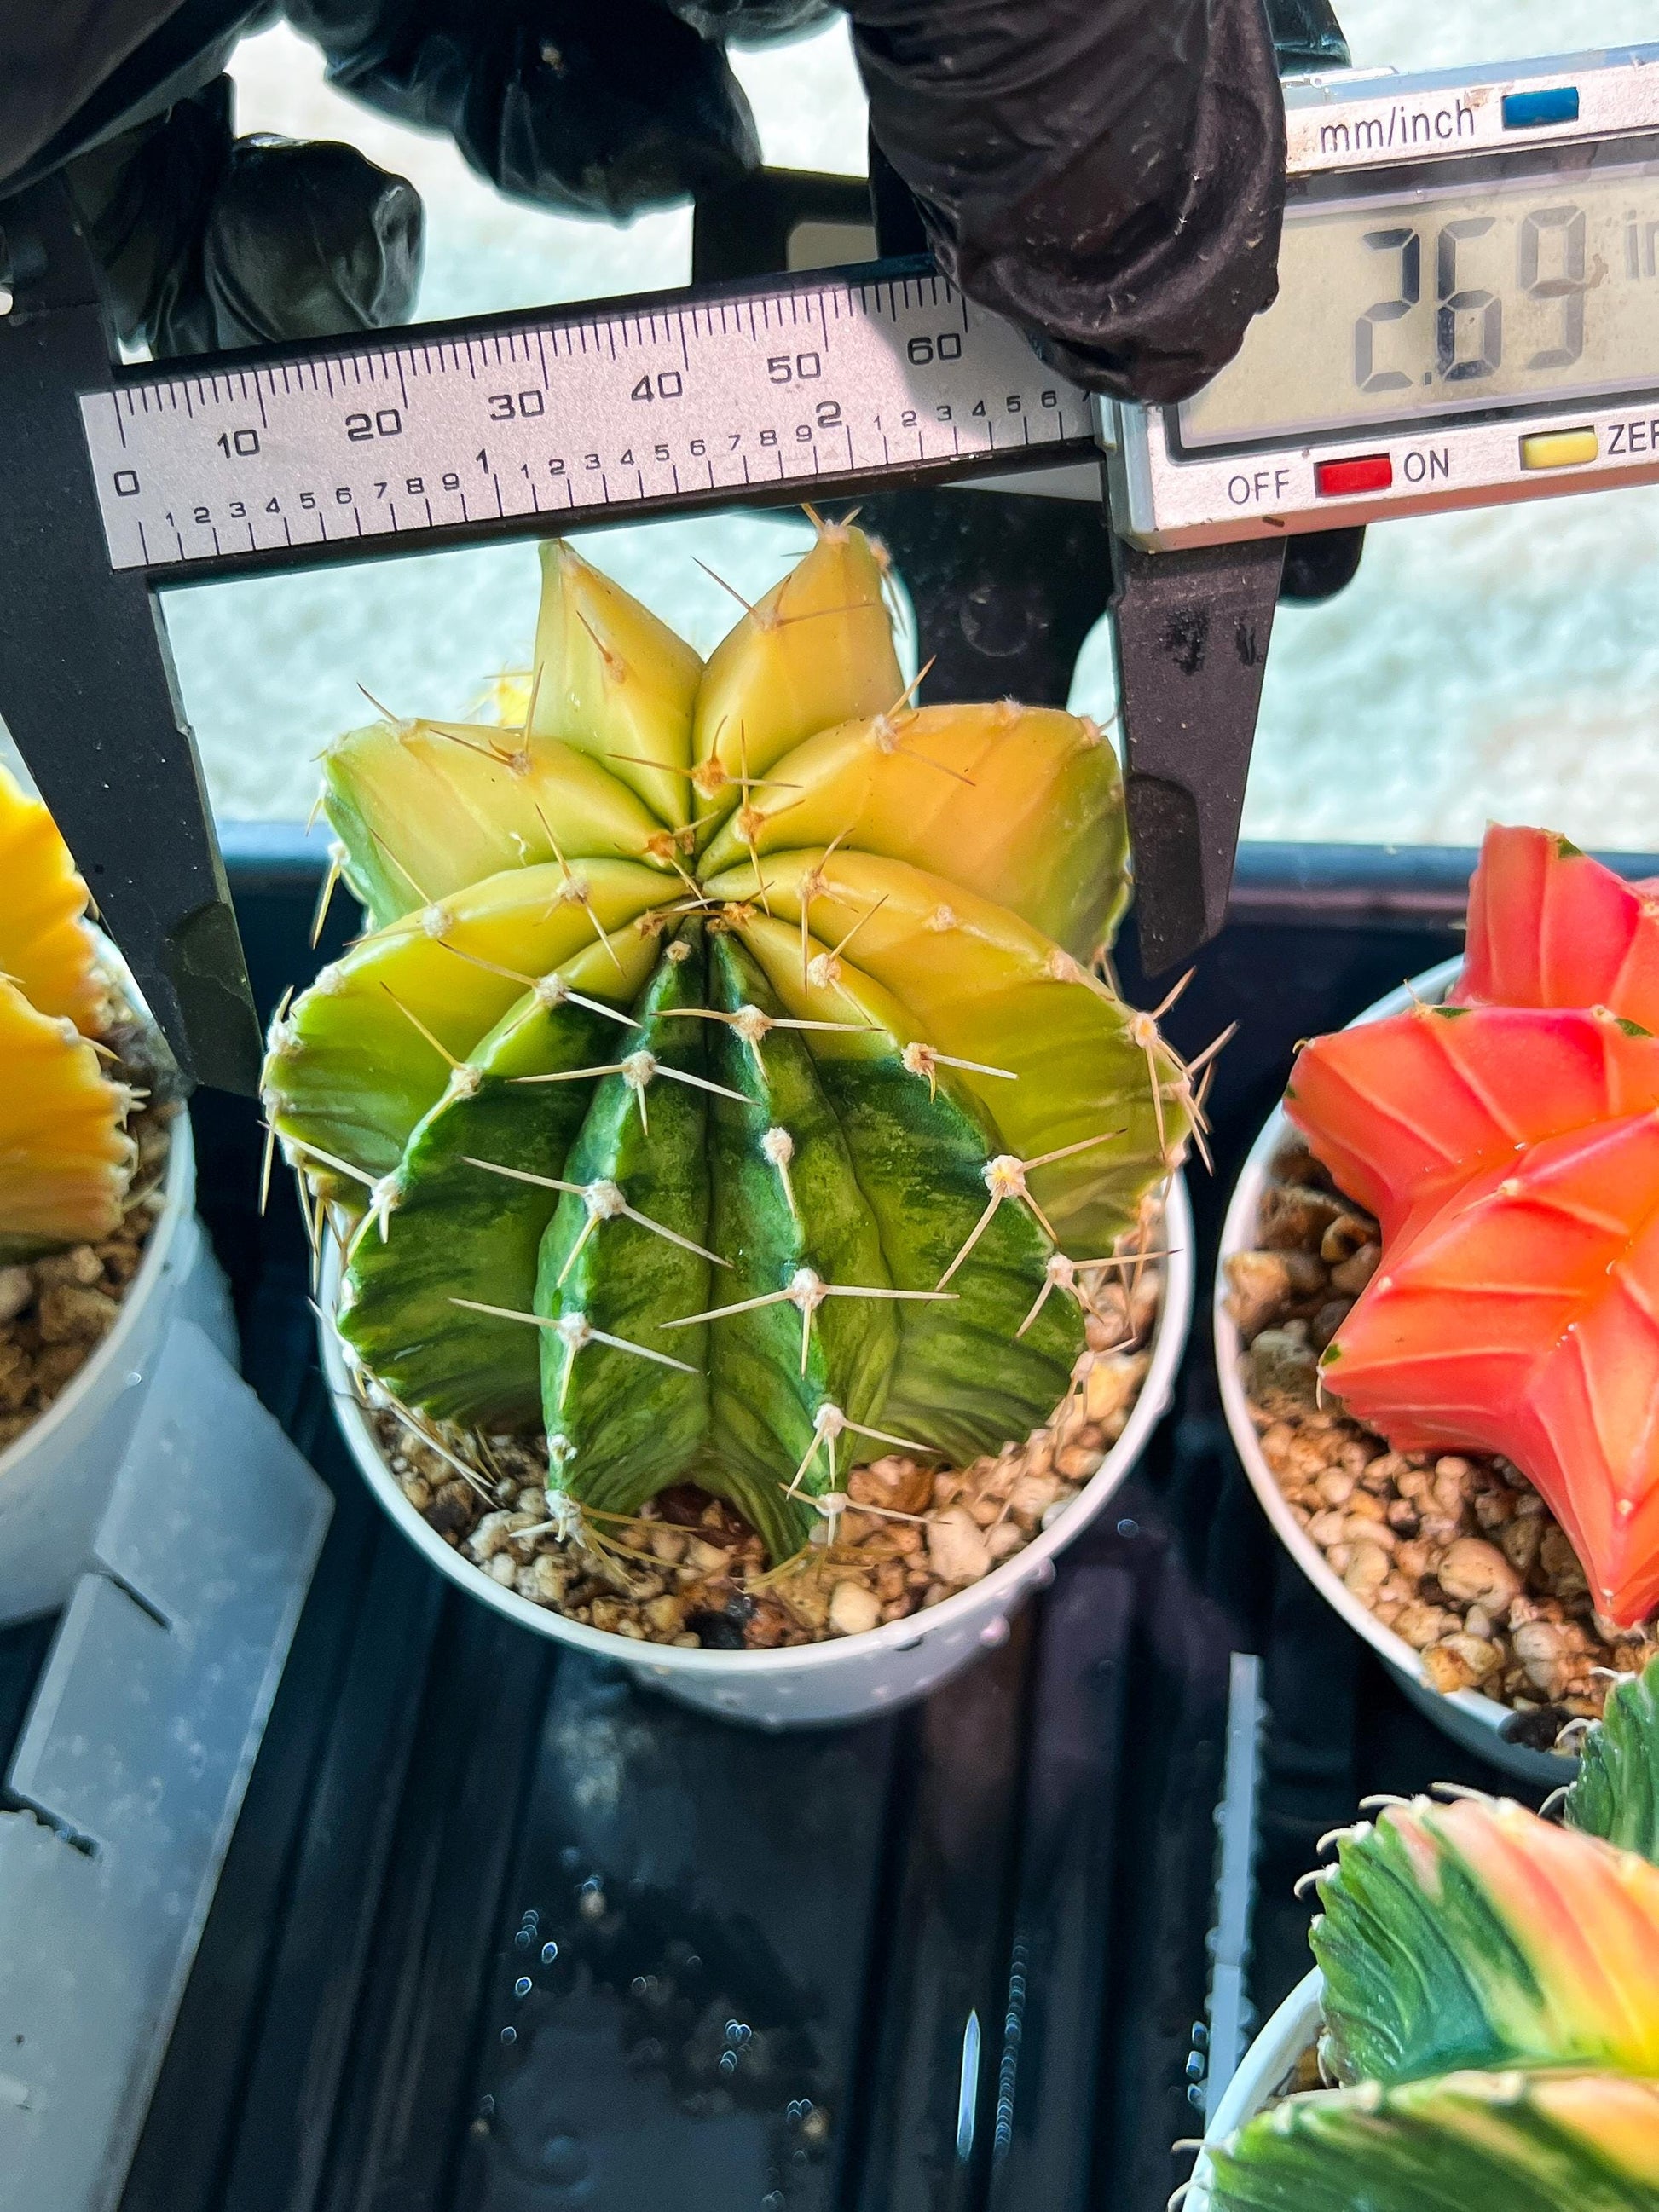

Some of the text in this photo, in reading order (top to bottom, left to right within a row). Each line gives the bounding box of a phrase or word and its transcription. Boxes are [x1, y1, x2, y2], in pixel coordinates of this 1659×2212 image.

[1320, 100, 1476, 154] mm/inch
[114, 332, 962, 497] 0 10 20 30 40 50 60
[166, 390, 1056, 527] 1 2 3 4 5 6 7 8 9 1 1 2 3 4 5 6 7 8 9 2 1 2 3 4 5 6
[1228, 470, 1291, 505] OFF
[1403, 449, 1449, 483] ON
